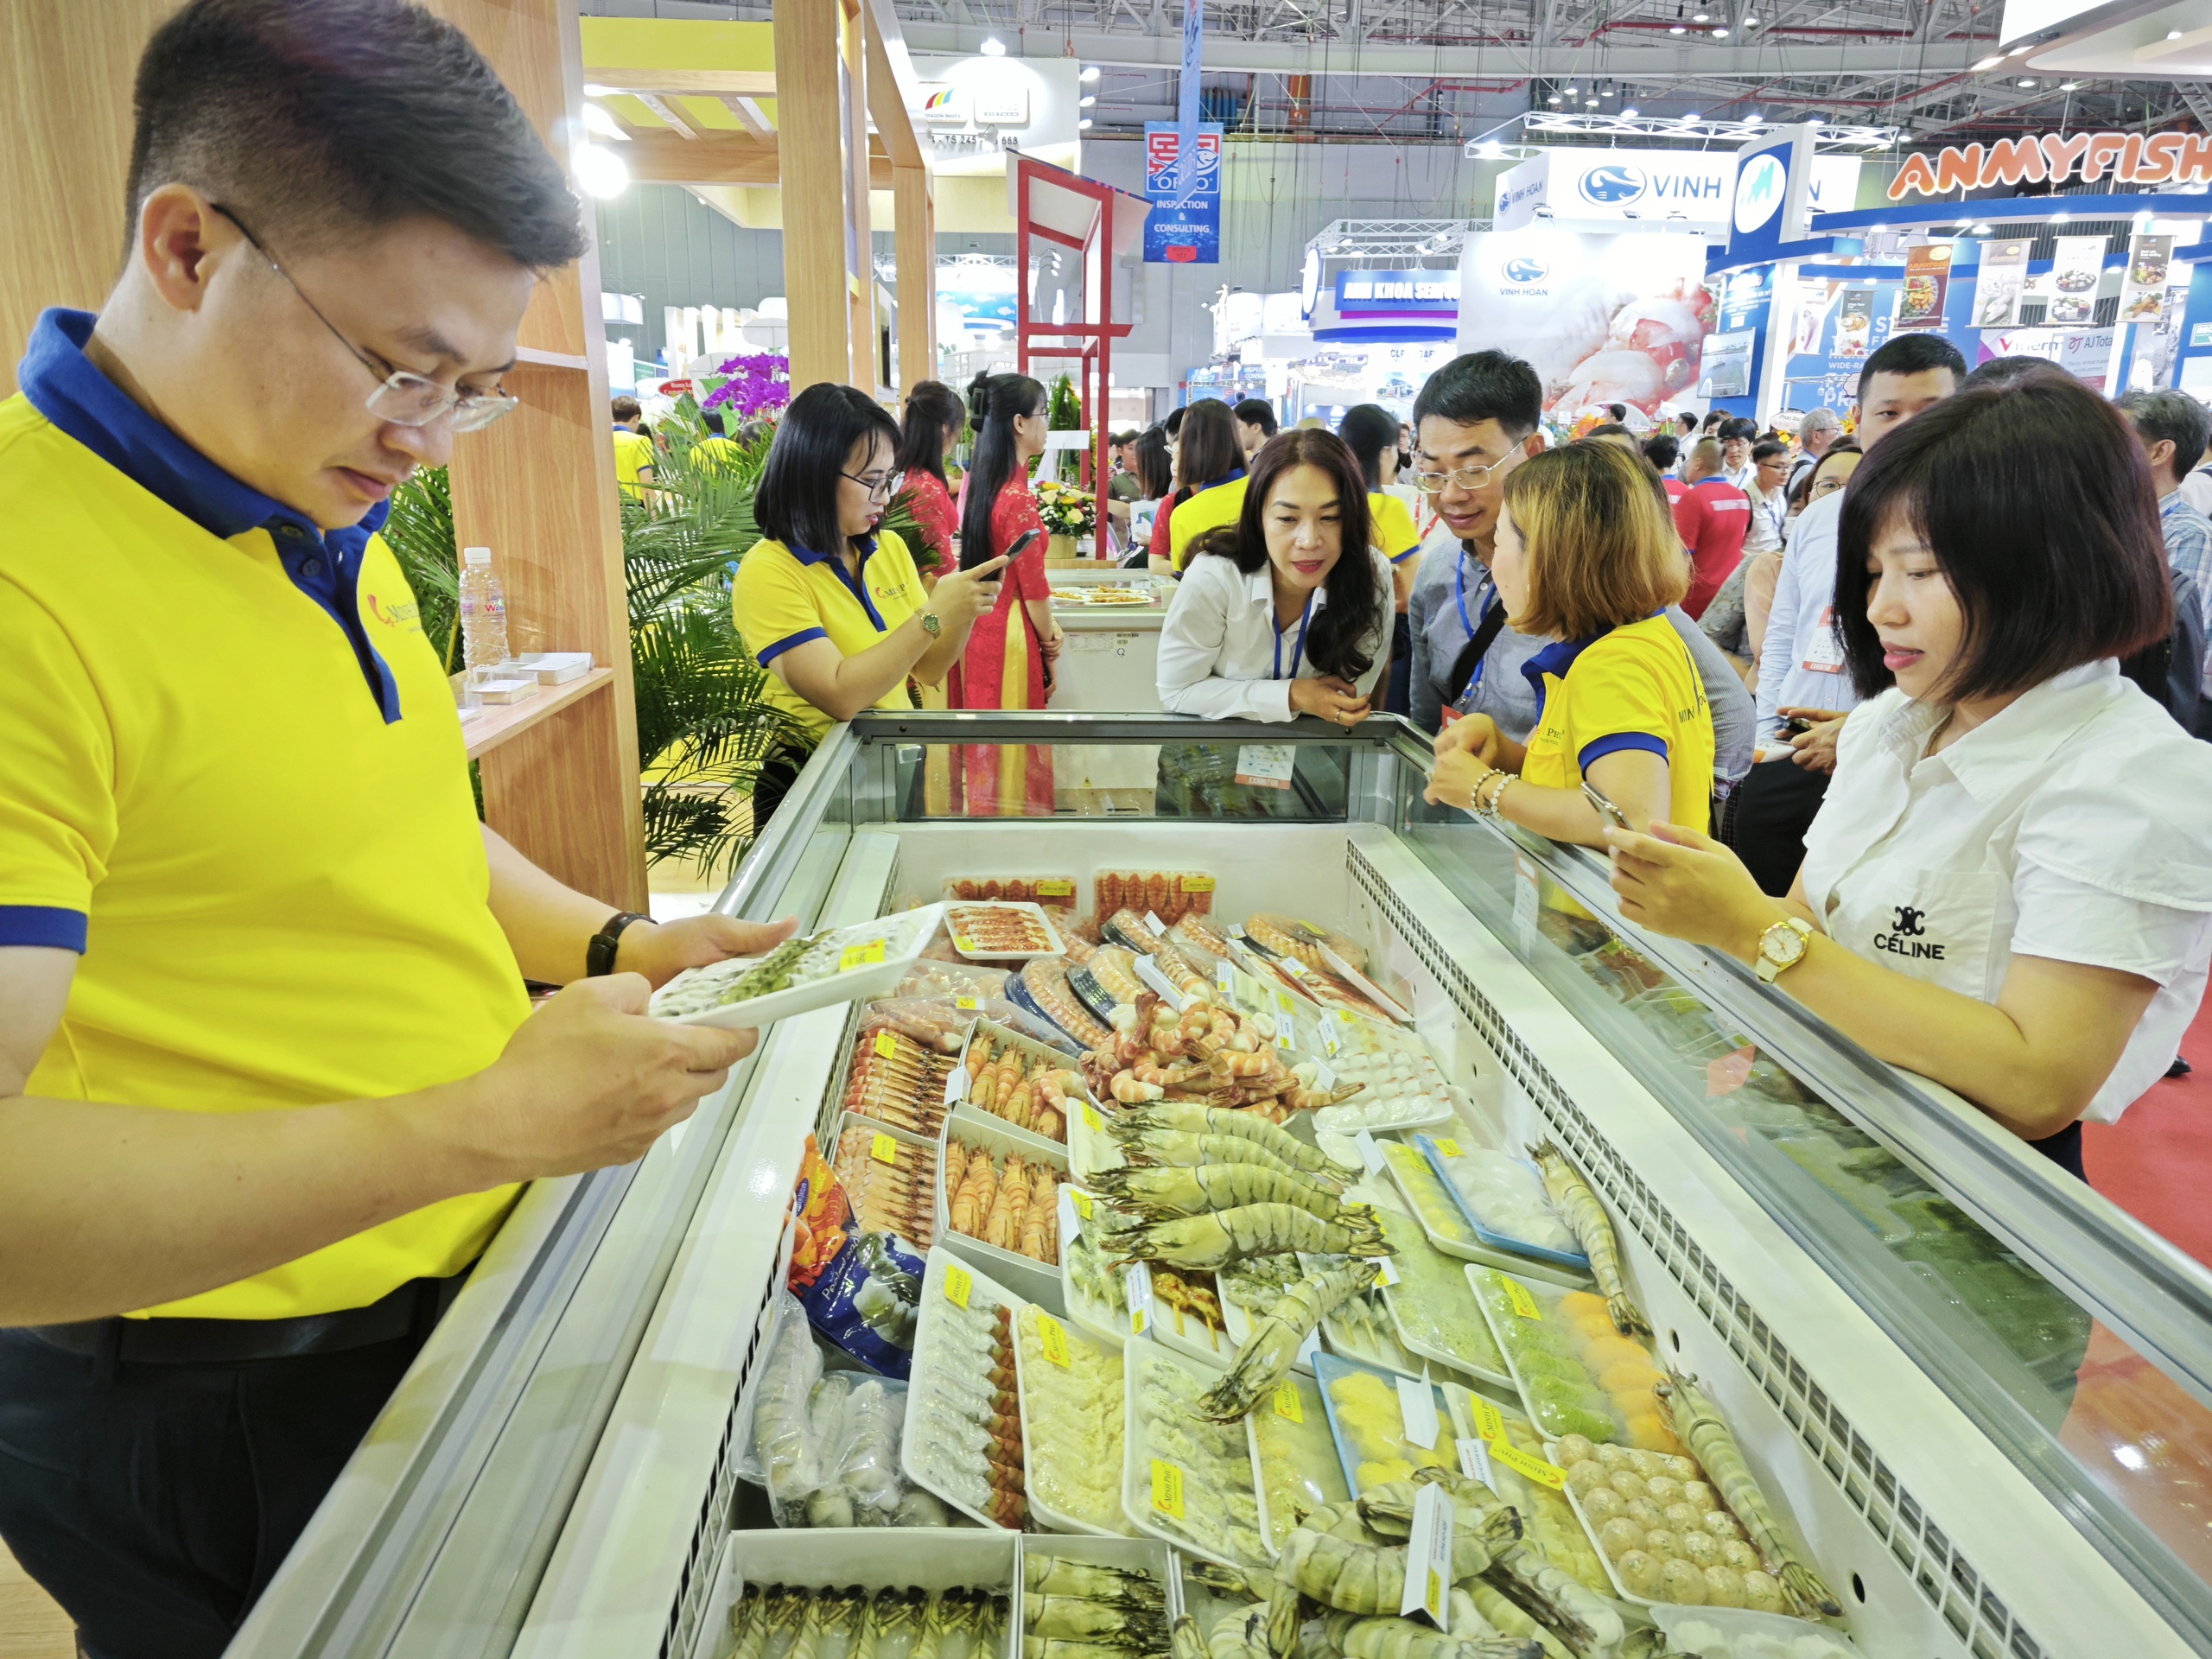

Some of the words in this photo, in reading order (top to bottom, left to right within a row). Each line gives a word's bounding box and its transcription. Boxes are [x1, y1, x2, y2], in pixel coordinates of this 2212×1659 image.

[961, 136, 976, 144] 245
[1001, 137, 1019, 145] 668
[1887, 132, 2212, 200] ANMYFISH
[1511, 187, 1525, 205] VINH
[1526, 180, 1543, 199] HOAN
[1653, 175, 1721, 200] VINH
[1179, 213, 1186, 221] &
[1154, 224, 1210, 233] CONSULTING
[1374, 283, 1414, 301] KHOA
[1873, 933, 1945, 960] CÉLINE
[1497, 1448, 1519, 1462] PHU
[1518, 1459, 1548, 1478] MINH
